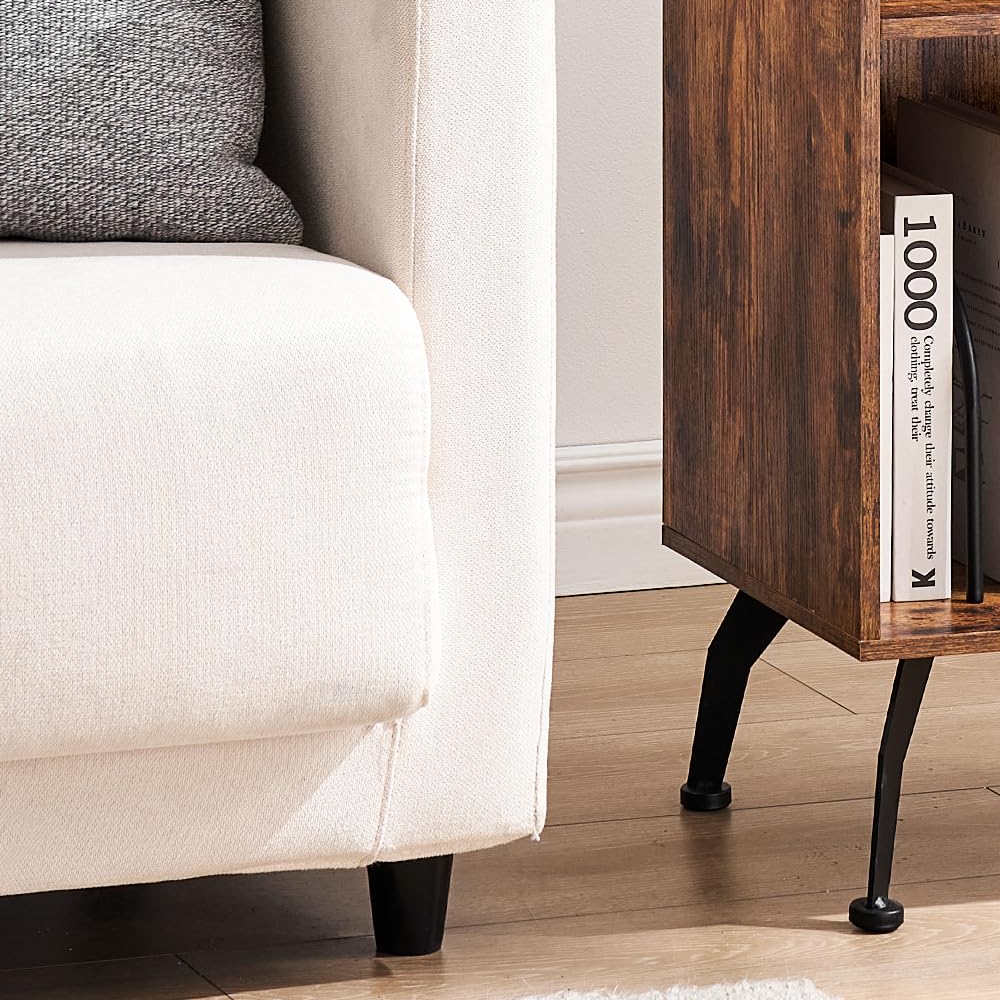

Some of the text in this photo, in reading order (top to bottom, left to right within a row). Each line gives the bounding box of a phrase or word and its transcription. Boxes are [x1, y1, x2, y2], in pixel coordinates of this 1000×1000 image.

[903, 215, 938, 331] 1000
[908, 336, 922, 442] clothing, treat their
[921, 335, 937, 560] Completely change their attitude towards
[911, 567, 936, 589] K
